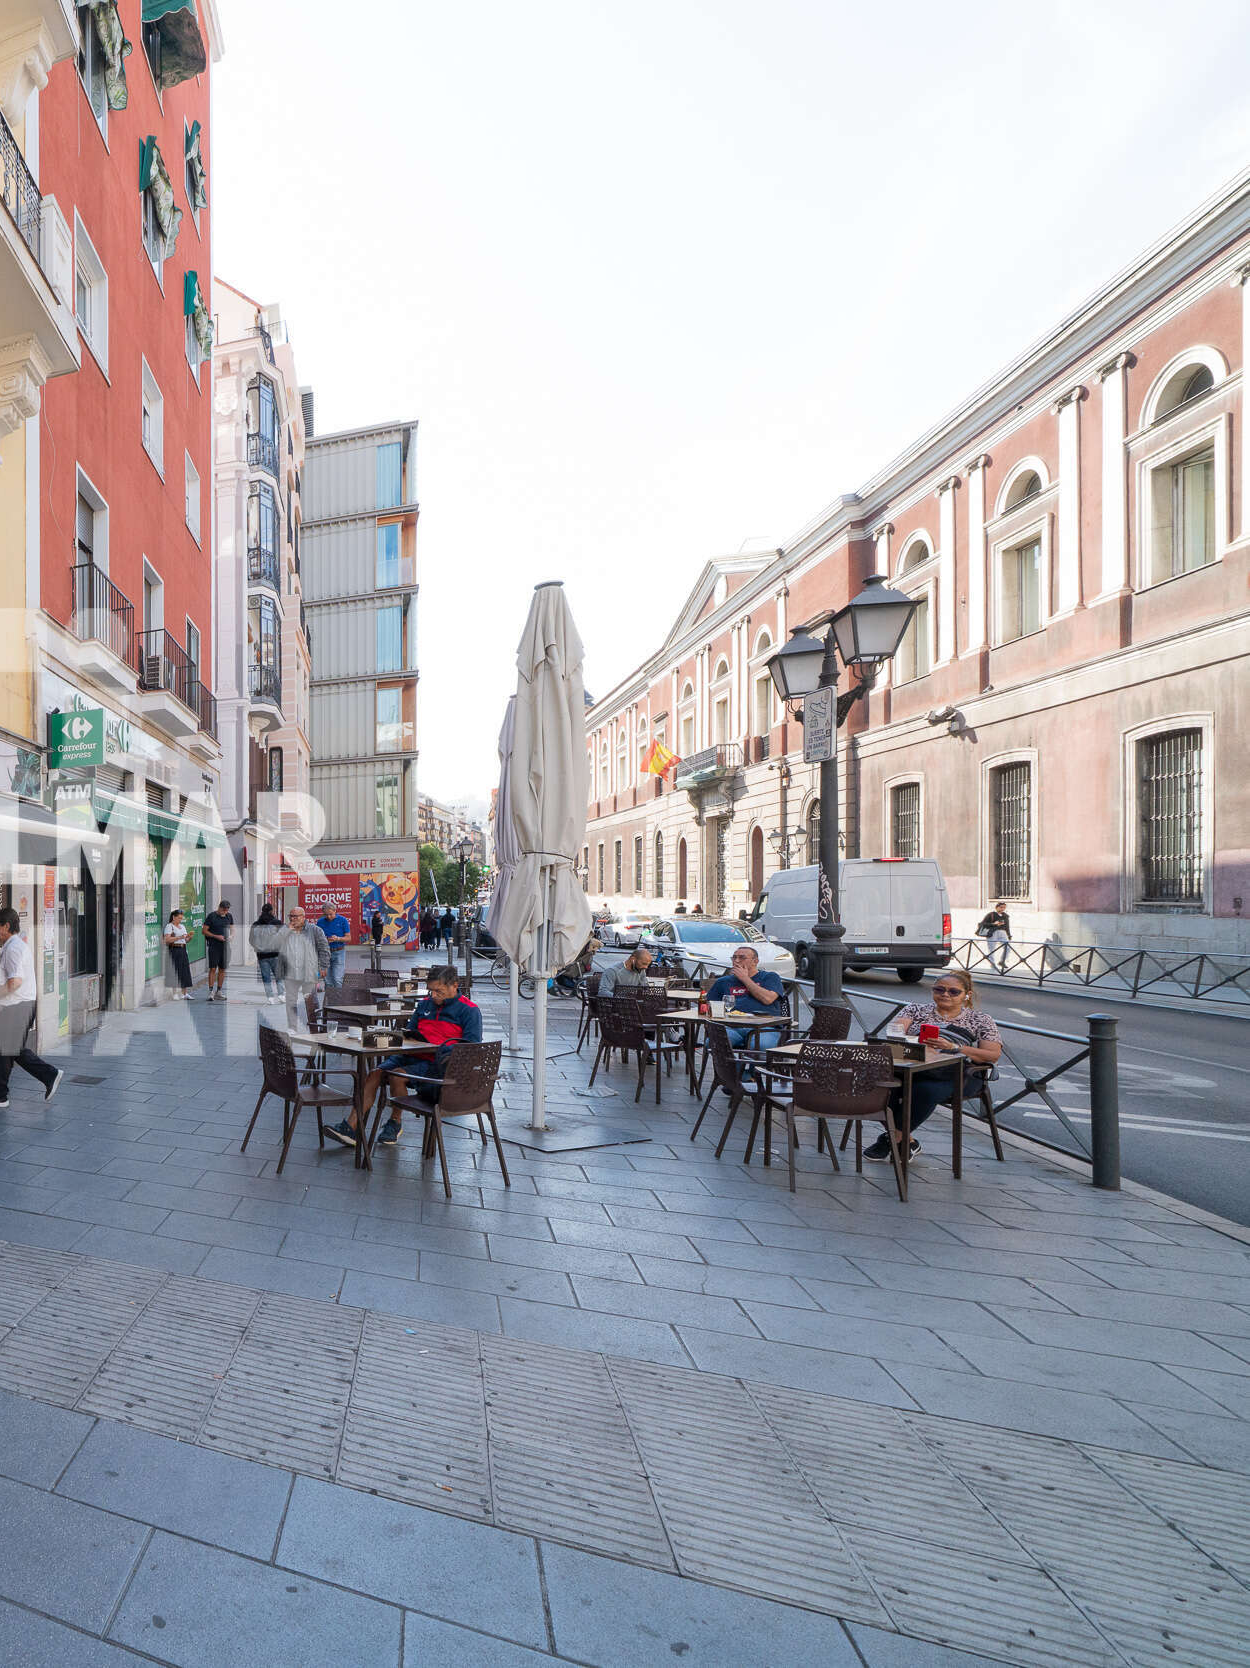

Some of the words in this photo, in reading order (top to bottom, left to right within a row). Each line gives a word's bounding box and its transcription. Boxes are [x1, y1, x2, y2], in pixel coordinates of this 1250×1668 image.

[58, 742, 97, 752] Carrefour
[63, 751, 91, 760] express
[54, 784, 91, 800] ATM
[305, 892, 352, 904] ENORME
